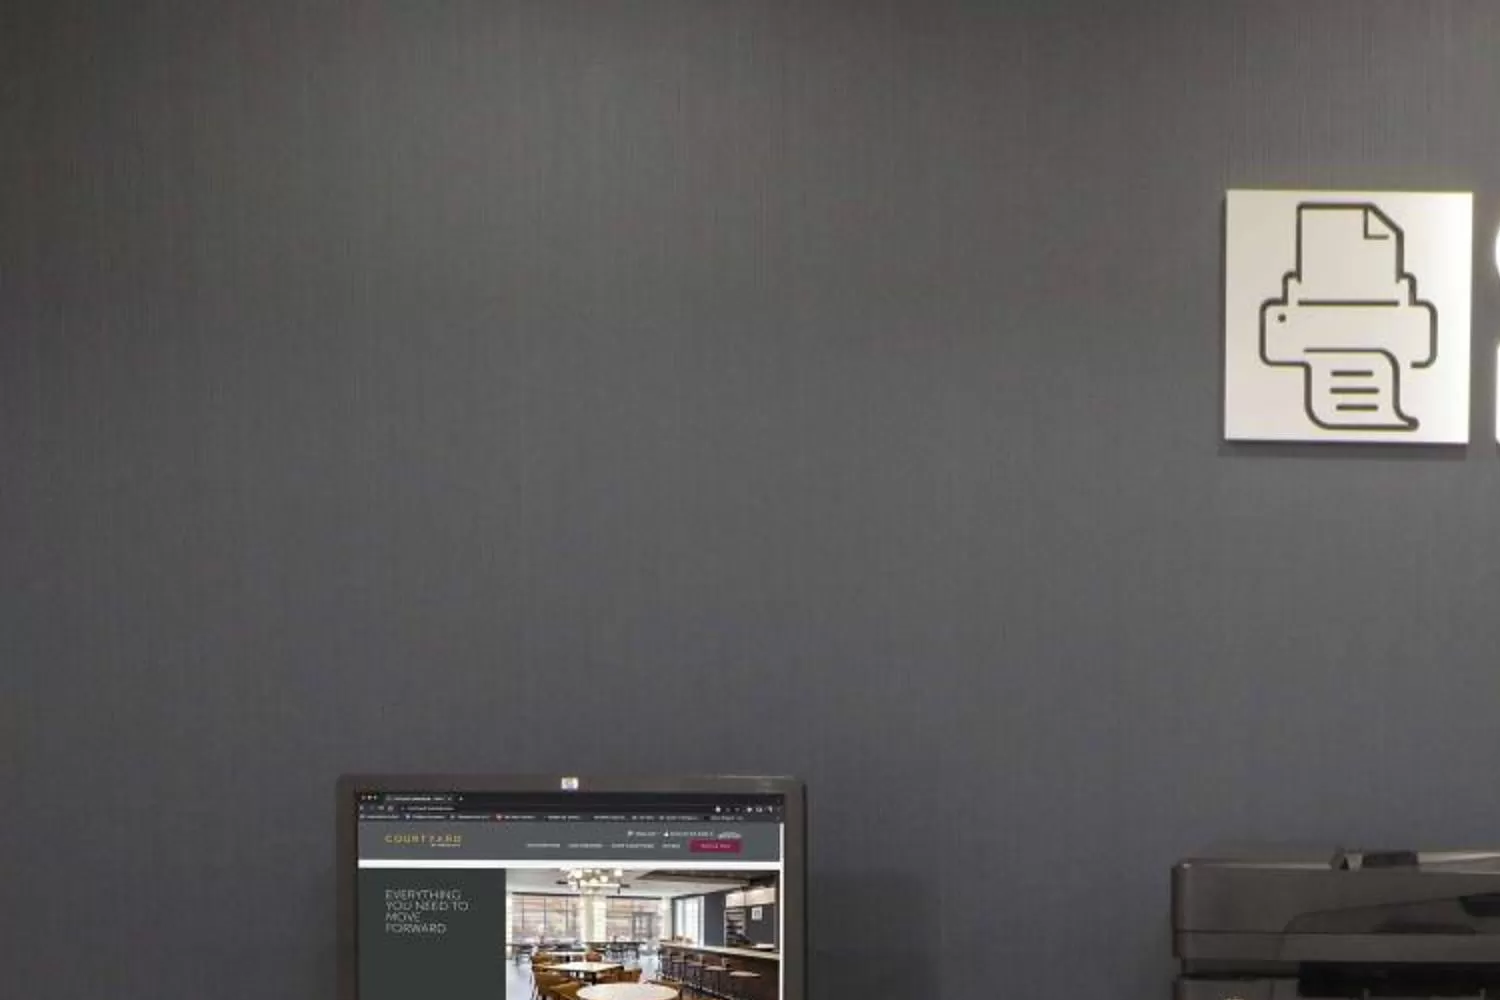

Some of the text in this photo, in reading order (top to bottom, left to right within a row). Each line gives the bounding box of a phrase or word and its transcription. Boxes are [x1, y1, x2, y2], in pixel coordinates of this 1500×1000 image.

[384, 888, 461, 900] EVERYTHING
[385, 900, 469, 911] YOU NEED TO
[384, 911, 421, 922] MOVE
[384, 923, 447, 933] FORWARD
